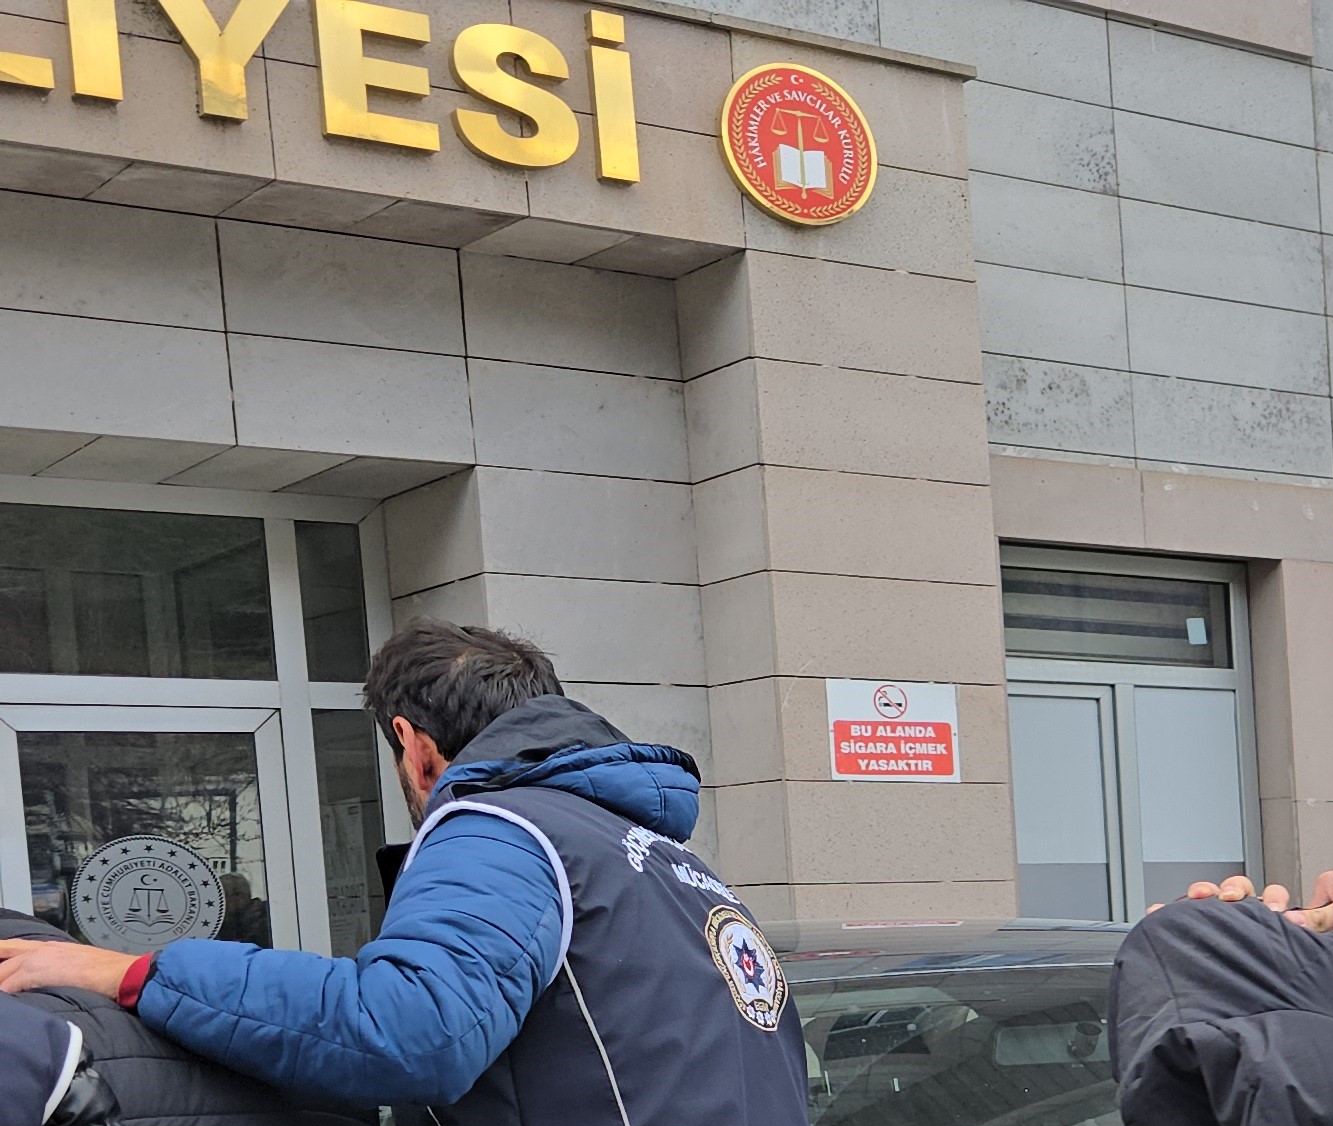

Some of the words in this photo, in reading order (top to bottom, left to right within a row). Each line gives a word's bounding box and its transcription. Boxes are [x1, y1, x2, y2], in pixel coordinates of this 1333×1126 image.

[767, 92, 783, 104] VE
[783, 89, 842, 128] SAVCILAR
[838, 129, 855, 184] KURULU
[851, 725, 872, 736] BU
[876, 726, 936, 737] ALANDA
[840, 740, 897, 754] SİGARA
[901, 740, 948, 757] İÇMEK
[858, 759, 932, 771] YASAKTIR
[158, 862, 192, 888] ADALET
